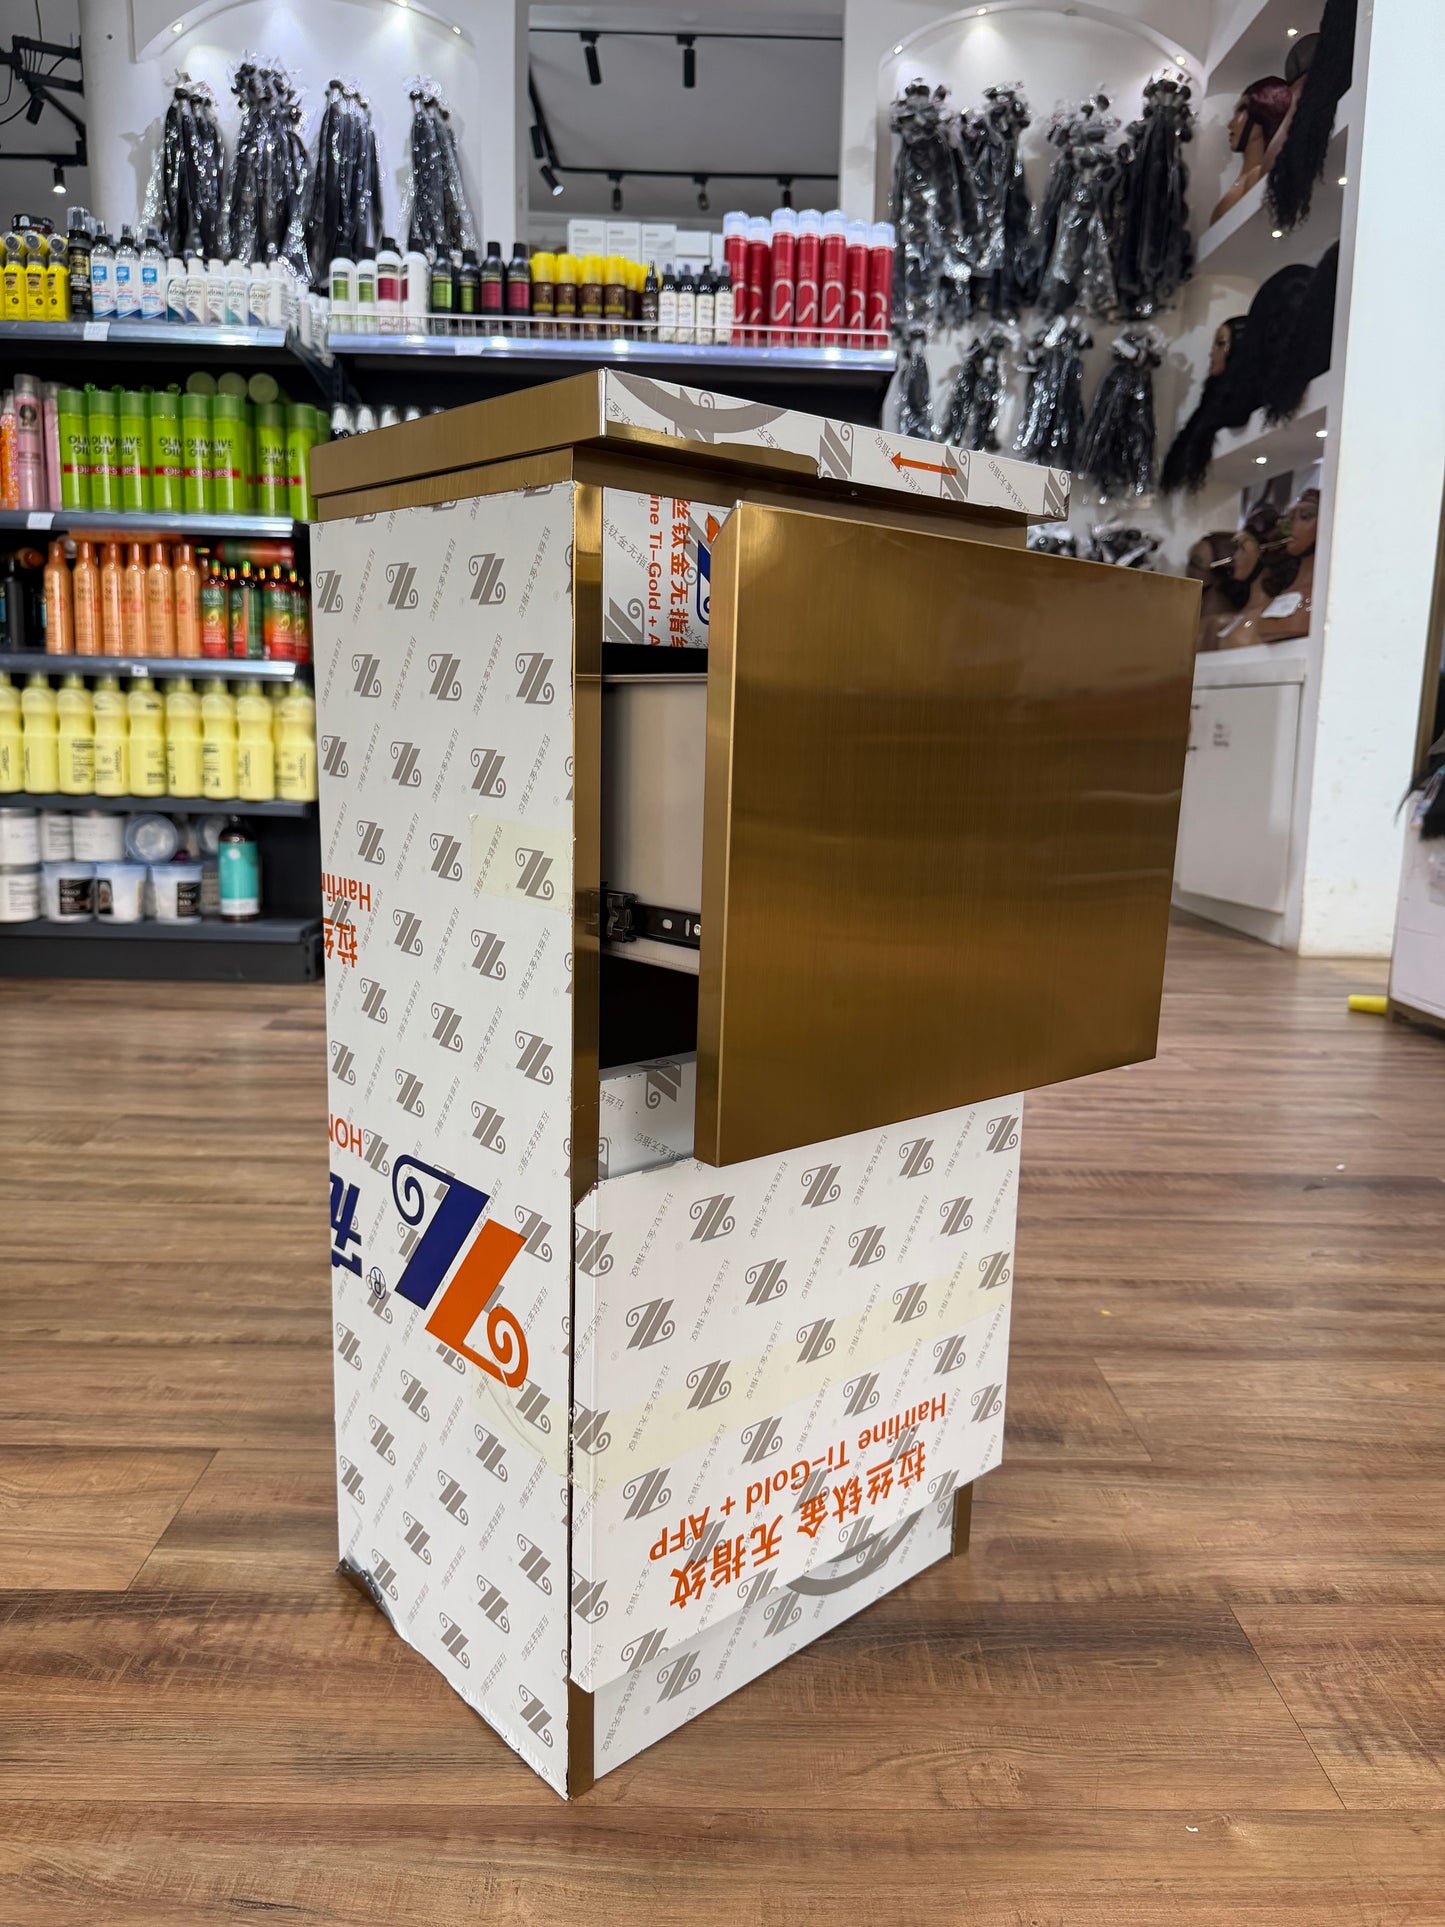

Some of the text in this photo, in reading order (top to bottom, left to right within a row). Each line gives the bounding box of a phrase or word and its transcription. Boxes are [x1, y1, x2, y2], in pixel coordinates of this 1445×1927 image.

[858, 1392, 946, 1450] Hairline
[746, 1440, 850, 1514] Ti-Gold
[649, 1506, 710, 1561] AFP
